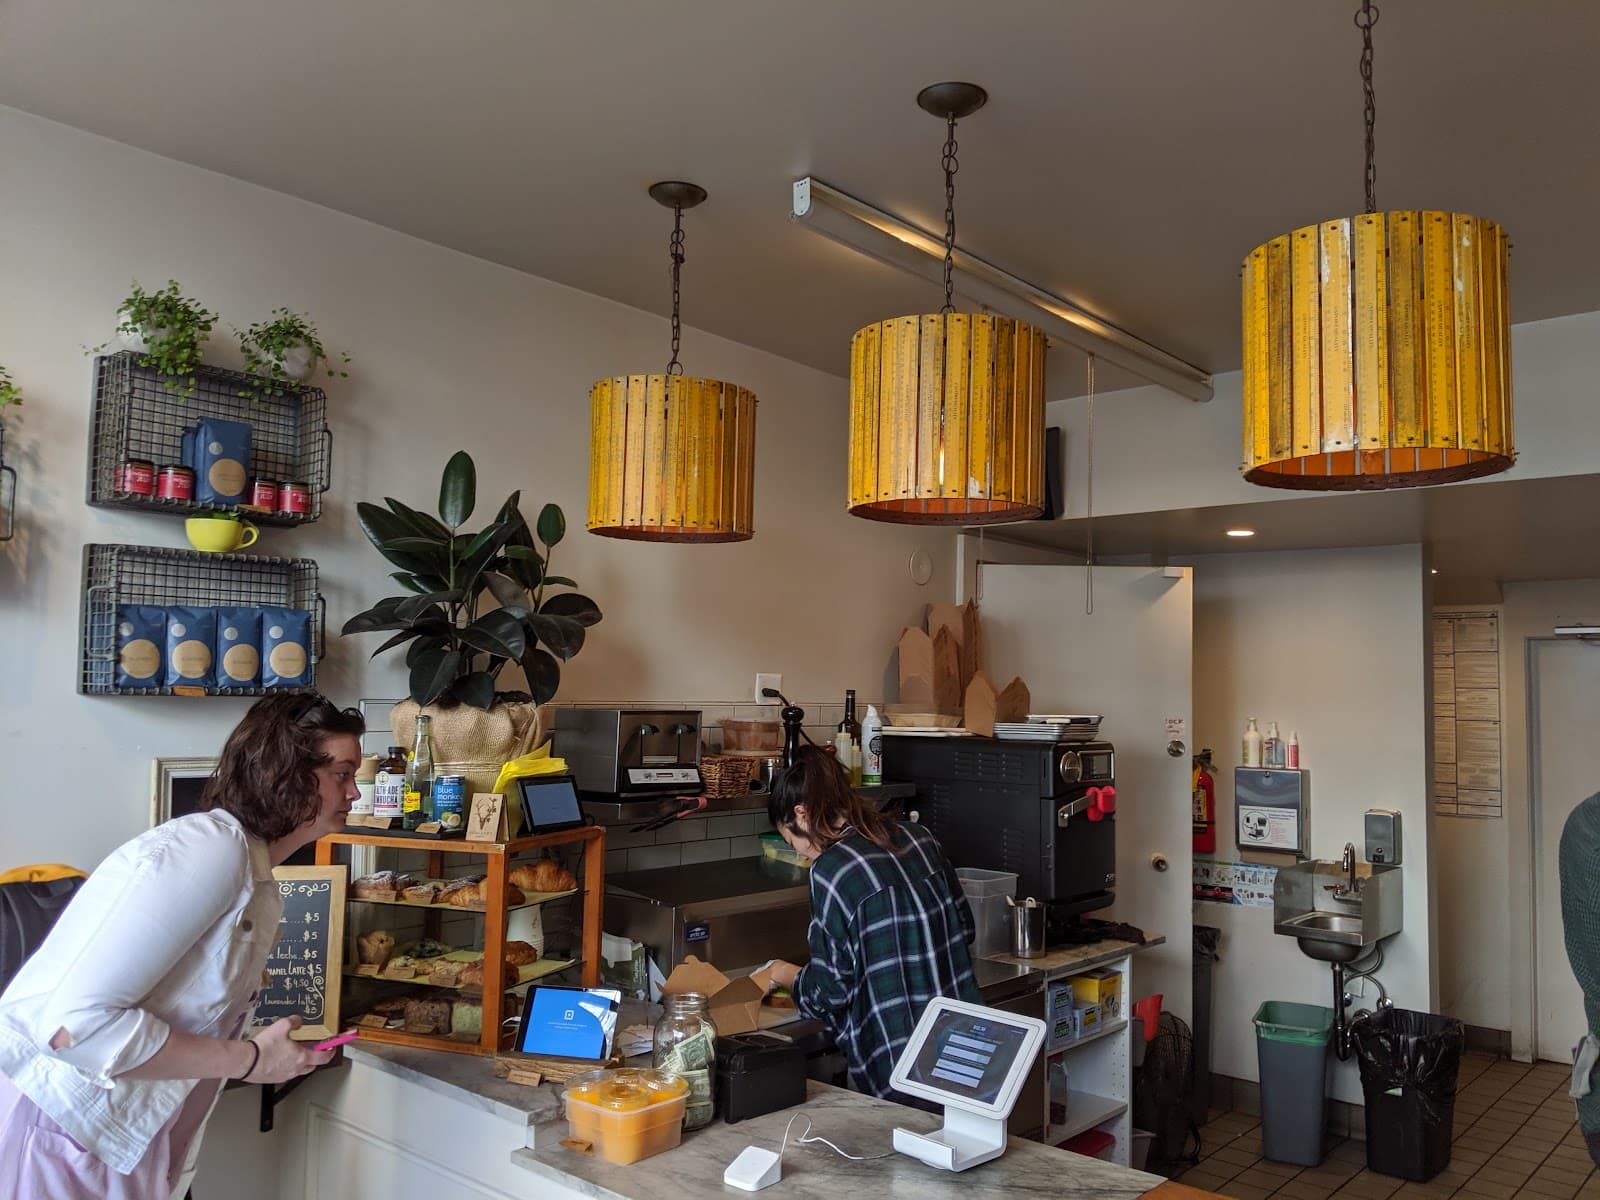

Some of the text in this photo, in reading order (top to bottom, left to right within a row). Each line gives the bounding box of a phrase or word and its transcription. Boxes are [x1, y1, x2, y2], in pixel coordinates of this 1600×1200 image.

[437, 784, 454, 794] blue
[304, 911, 320, 924] $5
[302, 929, 318, 943] $5
[303, 948, 318, 960] $5
[288, 960, 306, 975] LATTE
[306, 963, 322, 980] $5
